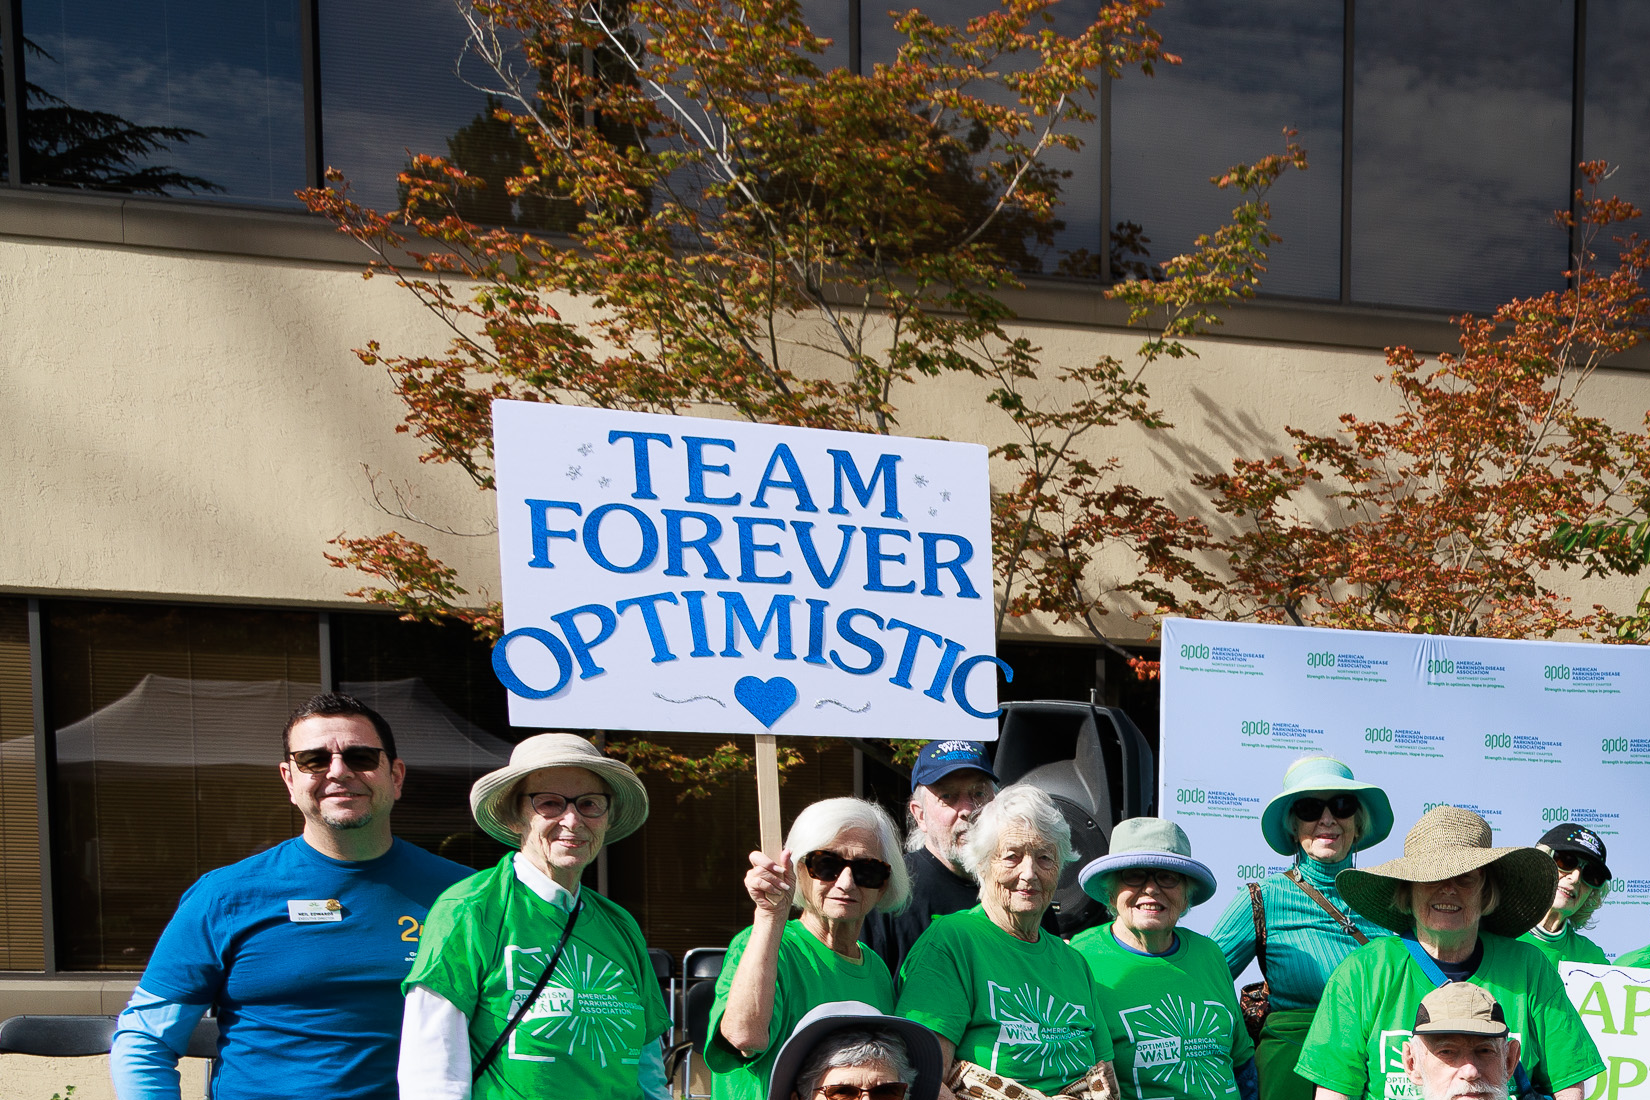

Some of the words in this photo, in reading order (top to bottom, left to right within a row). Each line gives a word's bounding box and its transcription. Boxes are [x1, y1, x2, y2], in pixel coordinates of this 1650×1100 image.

[608, 430, 904, 520] TEAM
[524, 498, 982, 599] FOREVER
[491, 590, 1014, 719] OPTIMISTIC
[1180, 643, 1209, 660] apda
[1307, 651, 1335, 668] apda
[1427, 658, 1454, 675] apda
[1544, 664, 1570, 682] apda
[1241, 719, 1270, 737] apda
[1365, 726, 1392, 744] apda
[1484, 732, 1511, 750] apda
[1602, 736, 1628, 754] apda
[1177, 788, 1205, 805] apda
[1542, 806, 1568, 824] apda
[1237, 864, 1265, 880] apda
[513, 992, 567, 1002] OPMISM
[577, 993, 618, 1001] AMERICAN
[578, 1000, 624, 1008] PARKINSON
[580, 1007, 632, 1016] ASSOCIATION
[1041, 1026, 1070, 1034] AMERICA
[1136, 1040, 1176, 1052] OPTIMISM
[1184, 1037, 1217, 1045] AMERICAN
